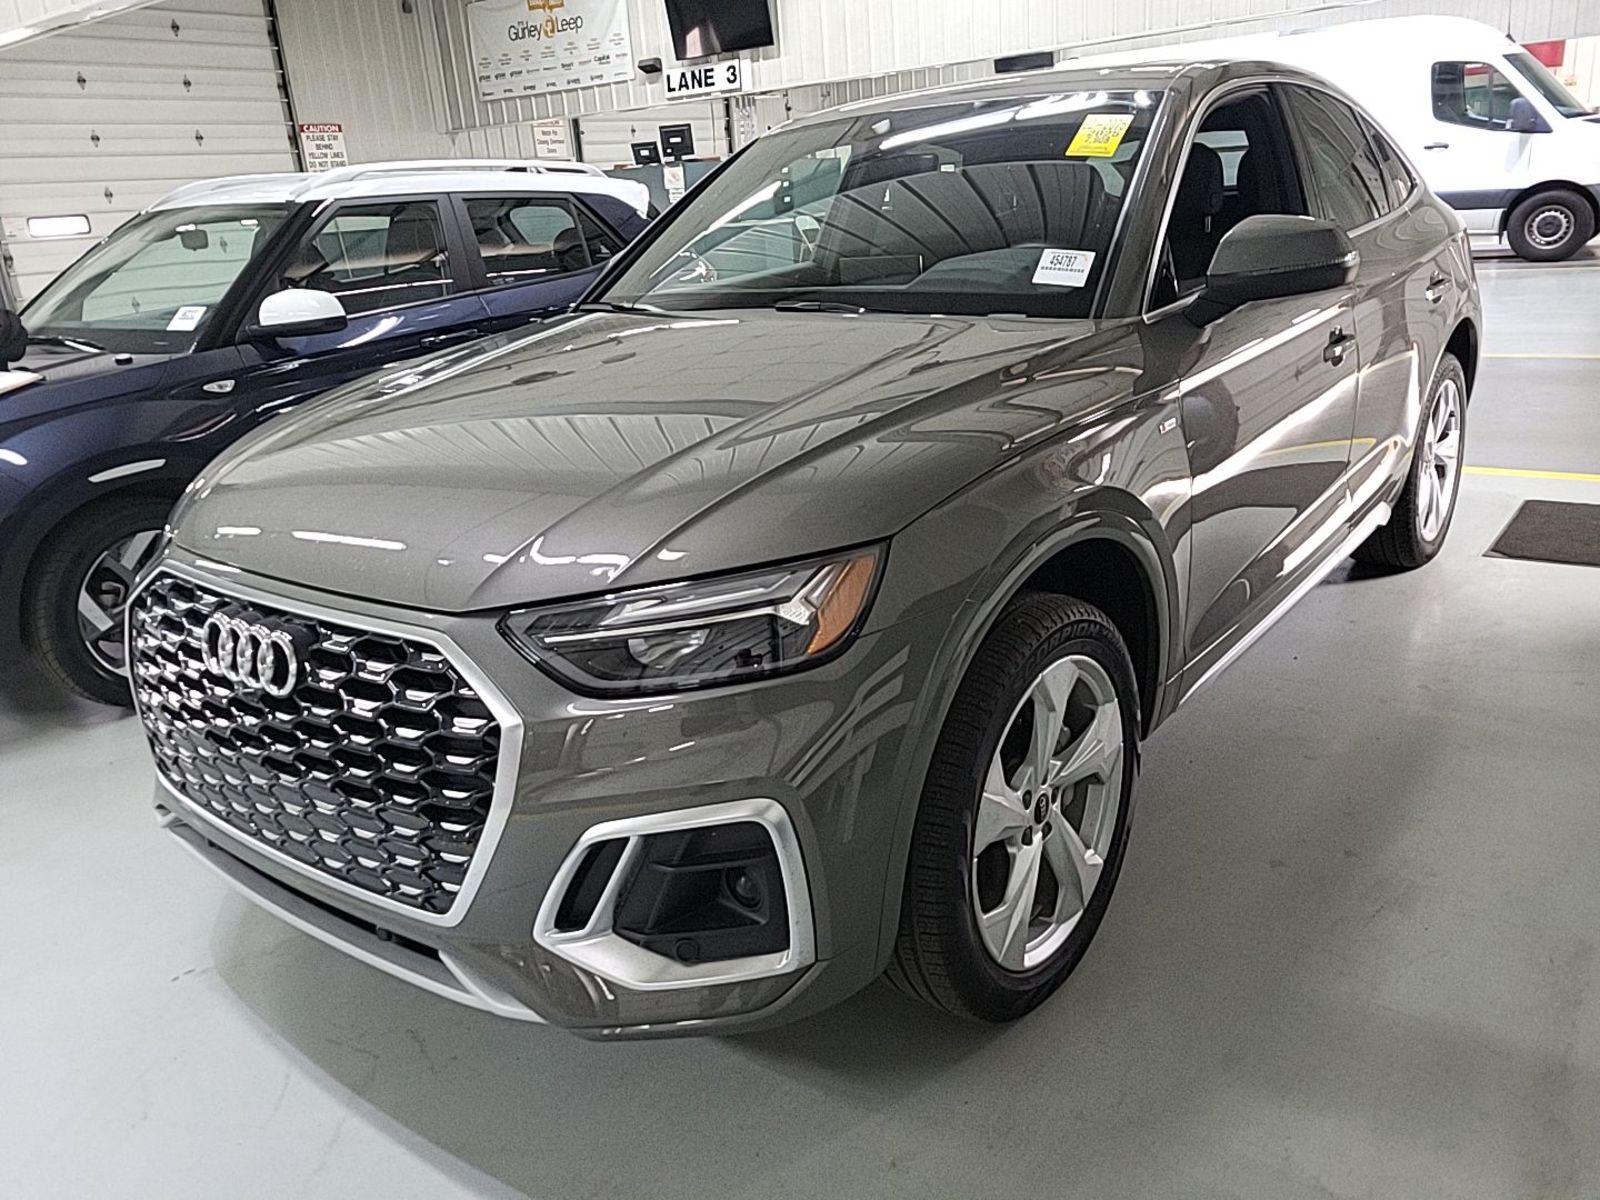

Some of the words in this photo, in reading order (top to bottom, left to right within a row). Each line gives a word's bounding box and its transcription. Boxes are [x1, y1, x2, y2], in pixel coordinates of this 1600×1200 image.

[556, 15, 583, 34] Leep
[666, 68, 715, 93] LANE
[726, 65, 738, 84] 3
[303, 124, 339, 132] CAUTION
